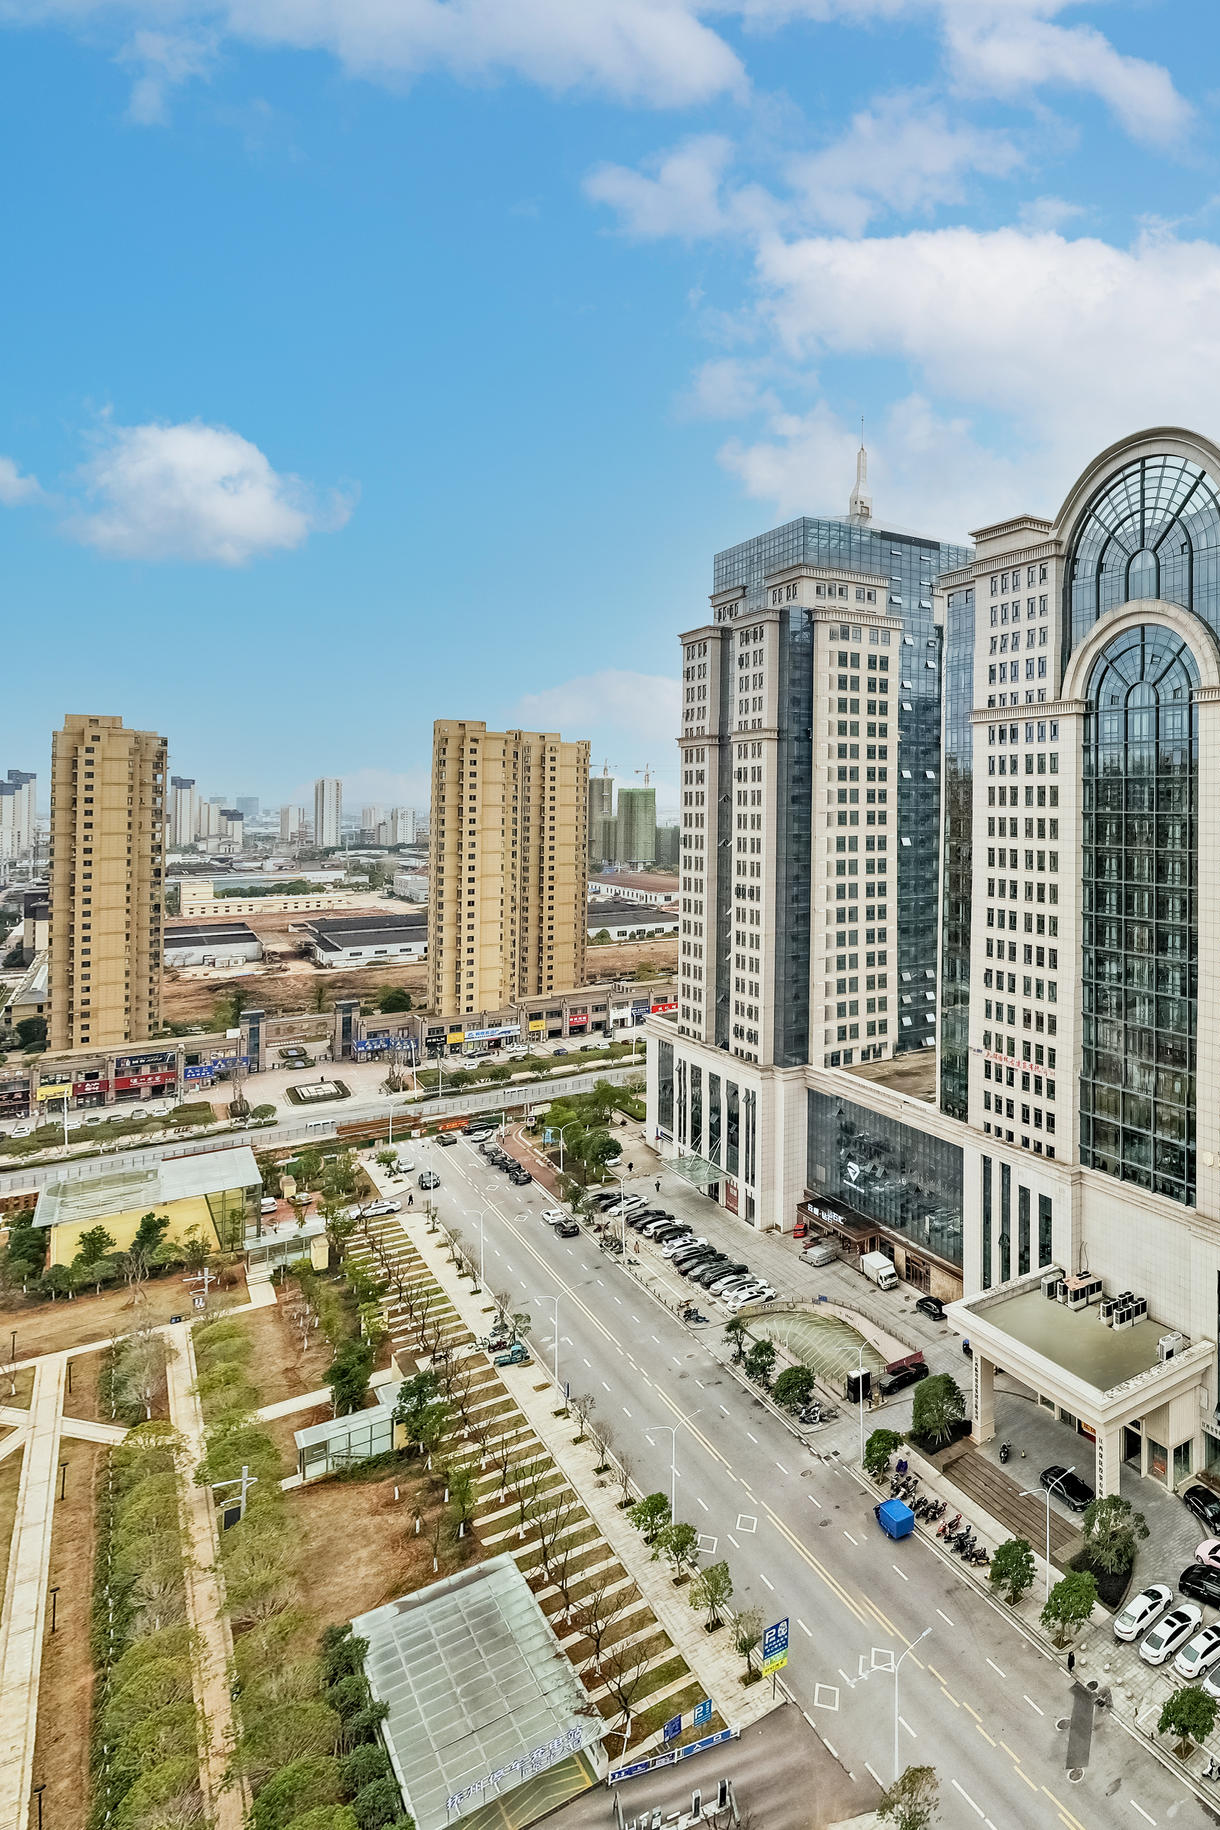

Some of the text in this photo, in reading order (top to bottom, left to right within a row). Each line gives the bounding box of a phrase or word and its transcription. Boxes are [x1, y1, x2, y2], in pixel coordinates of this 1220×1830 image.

[765, 1628, 776, 1645] P
[695, 1706, 704, 1719] P
[446, 1725, 582, 1809] 抚州停车充电站
